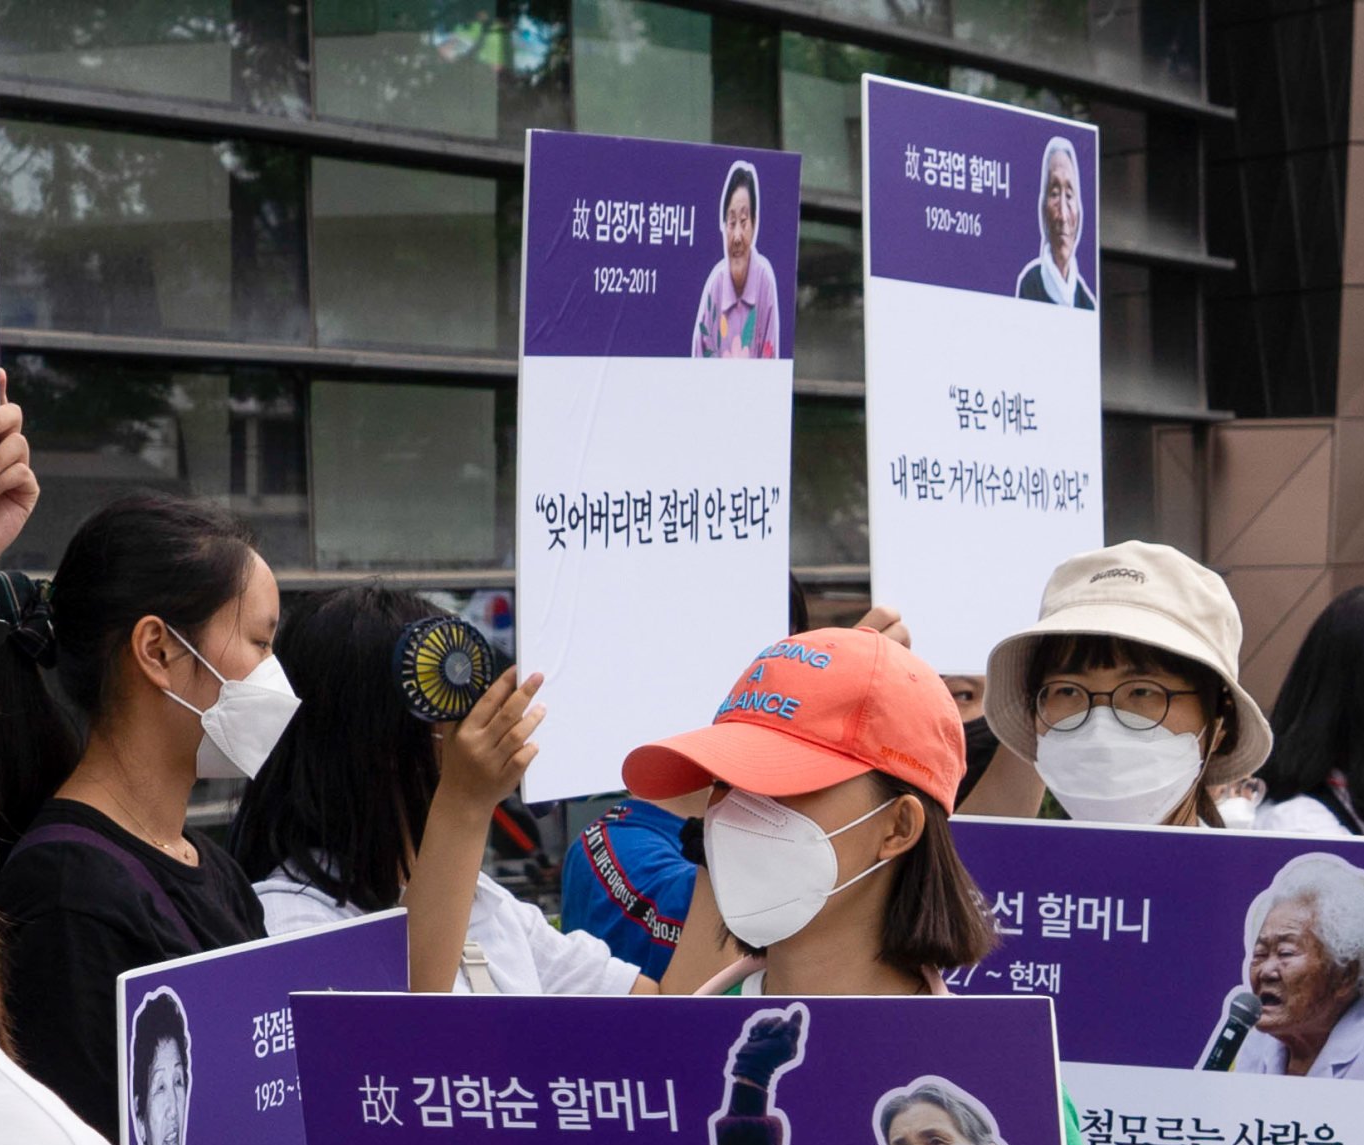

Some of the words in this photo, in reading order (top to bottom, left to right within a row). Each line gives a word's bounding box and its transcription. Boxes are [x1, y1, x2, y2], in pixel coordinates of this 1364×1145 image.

[922, 146, 967, 194] 공점엽
[969, 153, 1010, 199] 할머니
[572, 199, 591, 240] 故
[595, 199, 646, 244] 임정자
[649, 204, 695, 247] 할머니
[593, 267, 657, 295] 1922~2011
[991, 391, 1038, 436] 이래도
[890, 460, 908, 495] 내
[658, 490, 701, 545] 절대
[704, 488, 727, 541] 안
[747, 664, 765, 683] A
[988, 891, 1024, 935] 선
[1037, 892, 1150, 943] 할머니
[1009, 961, 1061, 994] 현재
[358, 1077, 402, 1127] 故
[412, 1075, 539, 1133] 김학순
[548, 1077, 680, 1137] 할머니
